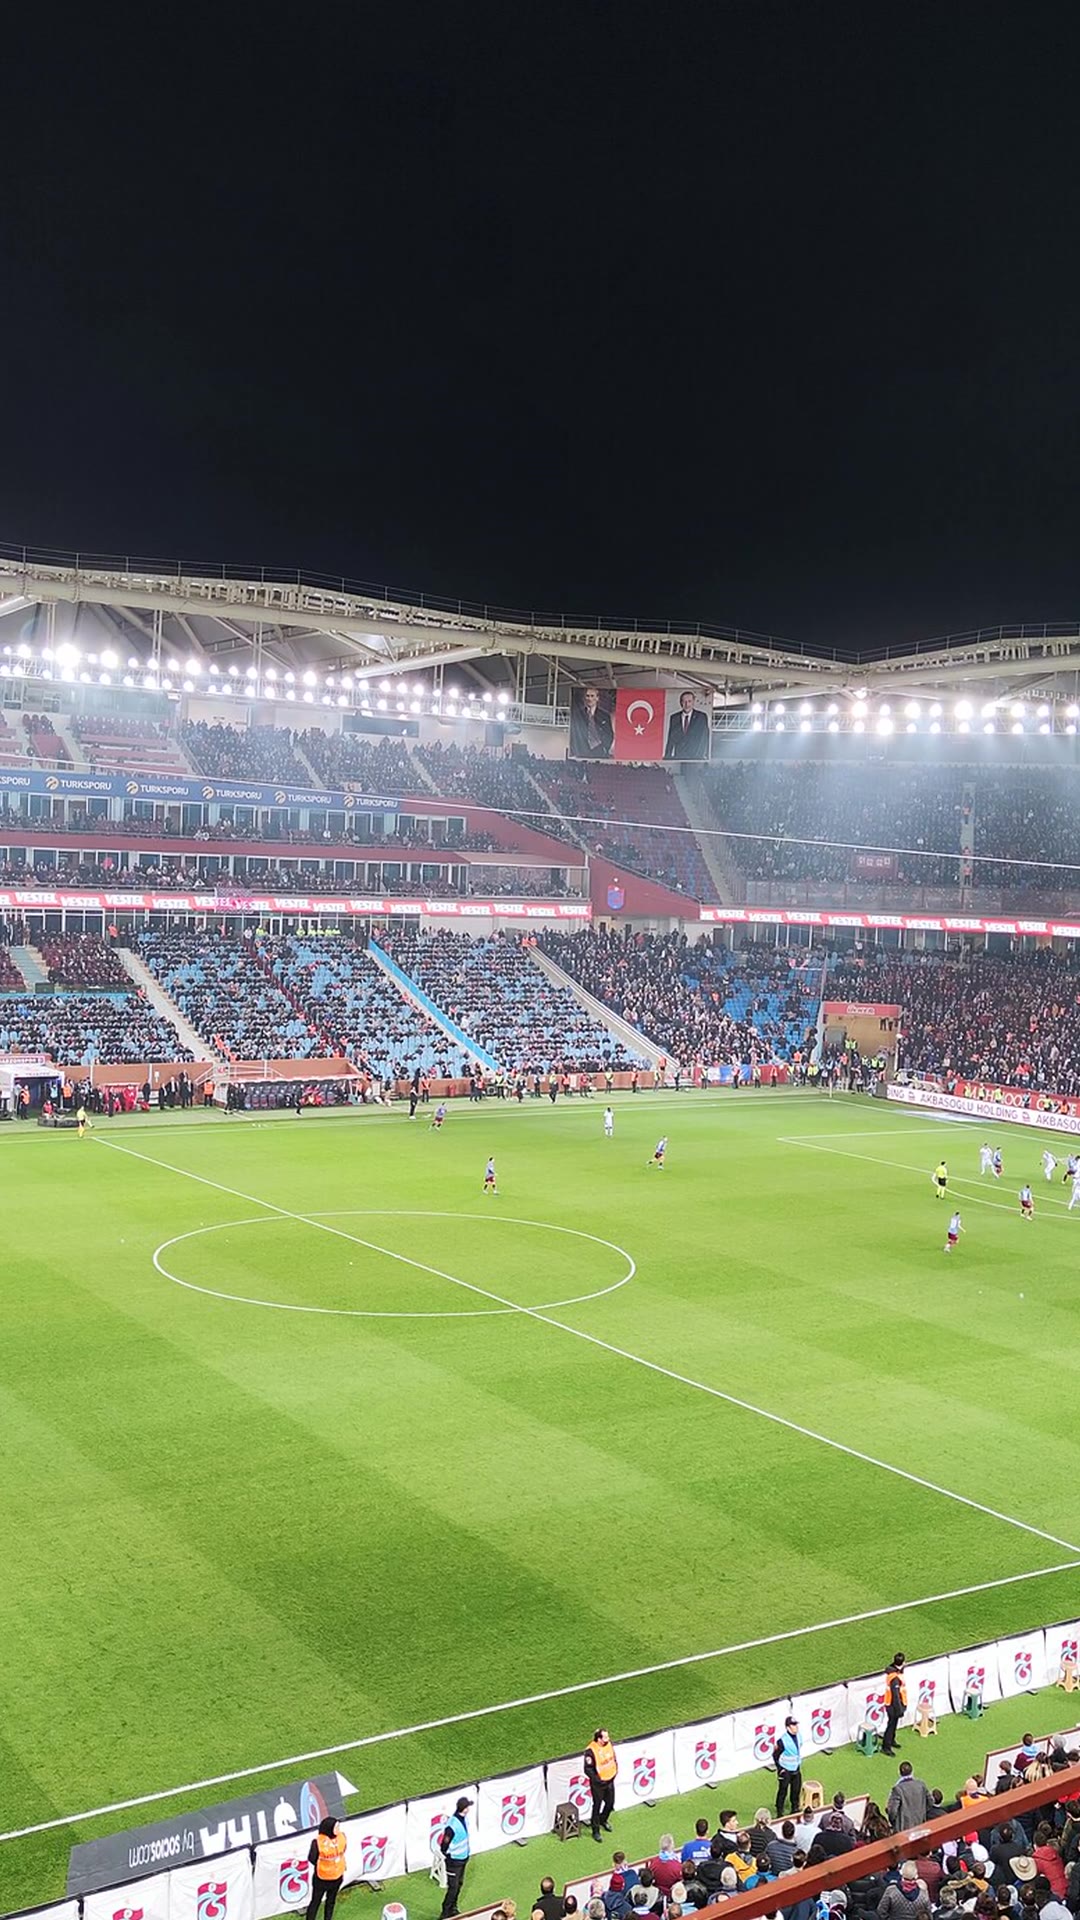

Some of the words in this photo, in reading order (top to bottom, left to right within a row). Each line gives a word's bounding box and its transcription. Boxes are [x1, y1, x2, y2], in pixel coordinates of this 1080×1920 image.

[15, 892, 57, 904] VESTEL
[60, 897, 101, 907] VESTEL
[104, 894, 145, 906] VESTEL
[151, 898, 192, 909] VESTEL
[273, 898, 311, 910] VESTEL
[312, 902, 347, 912] VESTEL
[350, 900, 385, 911] VESTEL
[390, 903, 423, 914] VESTEL
[425, 902, 458, 913] VESTEL
[493, 903, 526, 914] VESTEL
[460, 905, 493, 915] VESTEL
[527, 907, 557, 916] VESTEL
[559, 905, 589, 915] VESTEL
[716, 909, 746, 919] VESTEL
[748, 913, 784, 923] VESTEL
[785, 911, 822, 922] VESTEL
[828, 916, 865, 926] VESTEL
[866, 915, 904, 926] VESTEL
[906, 919, 944, 930] VESTEL
[944, 918, 983, 929] VESTEL
[984, 922, 1017, 933] VESTEL
[1017, 920, 1048, 932] VESTEL
[977, 1102, 1018, 1119] HOLDING
[182, 1829, 195, 1855] by
[128, 1835, 181, 1868] socios.com
